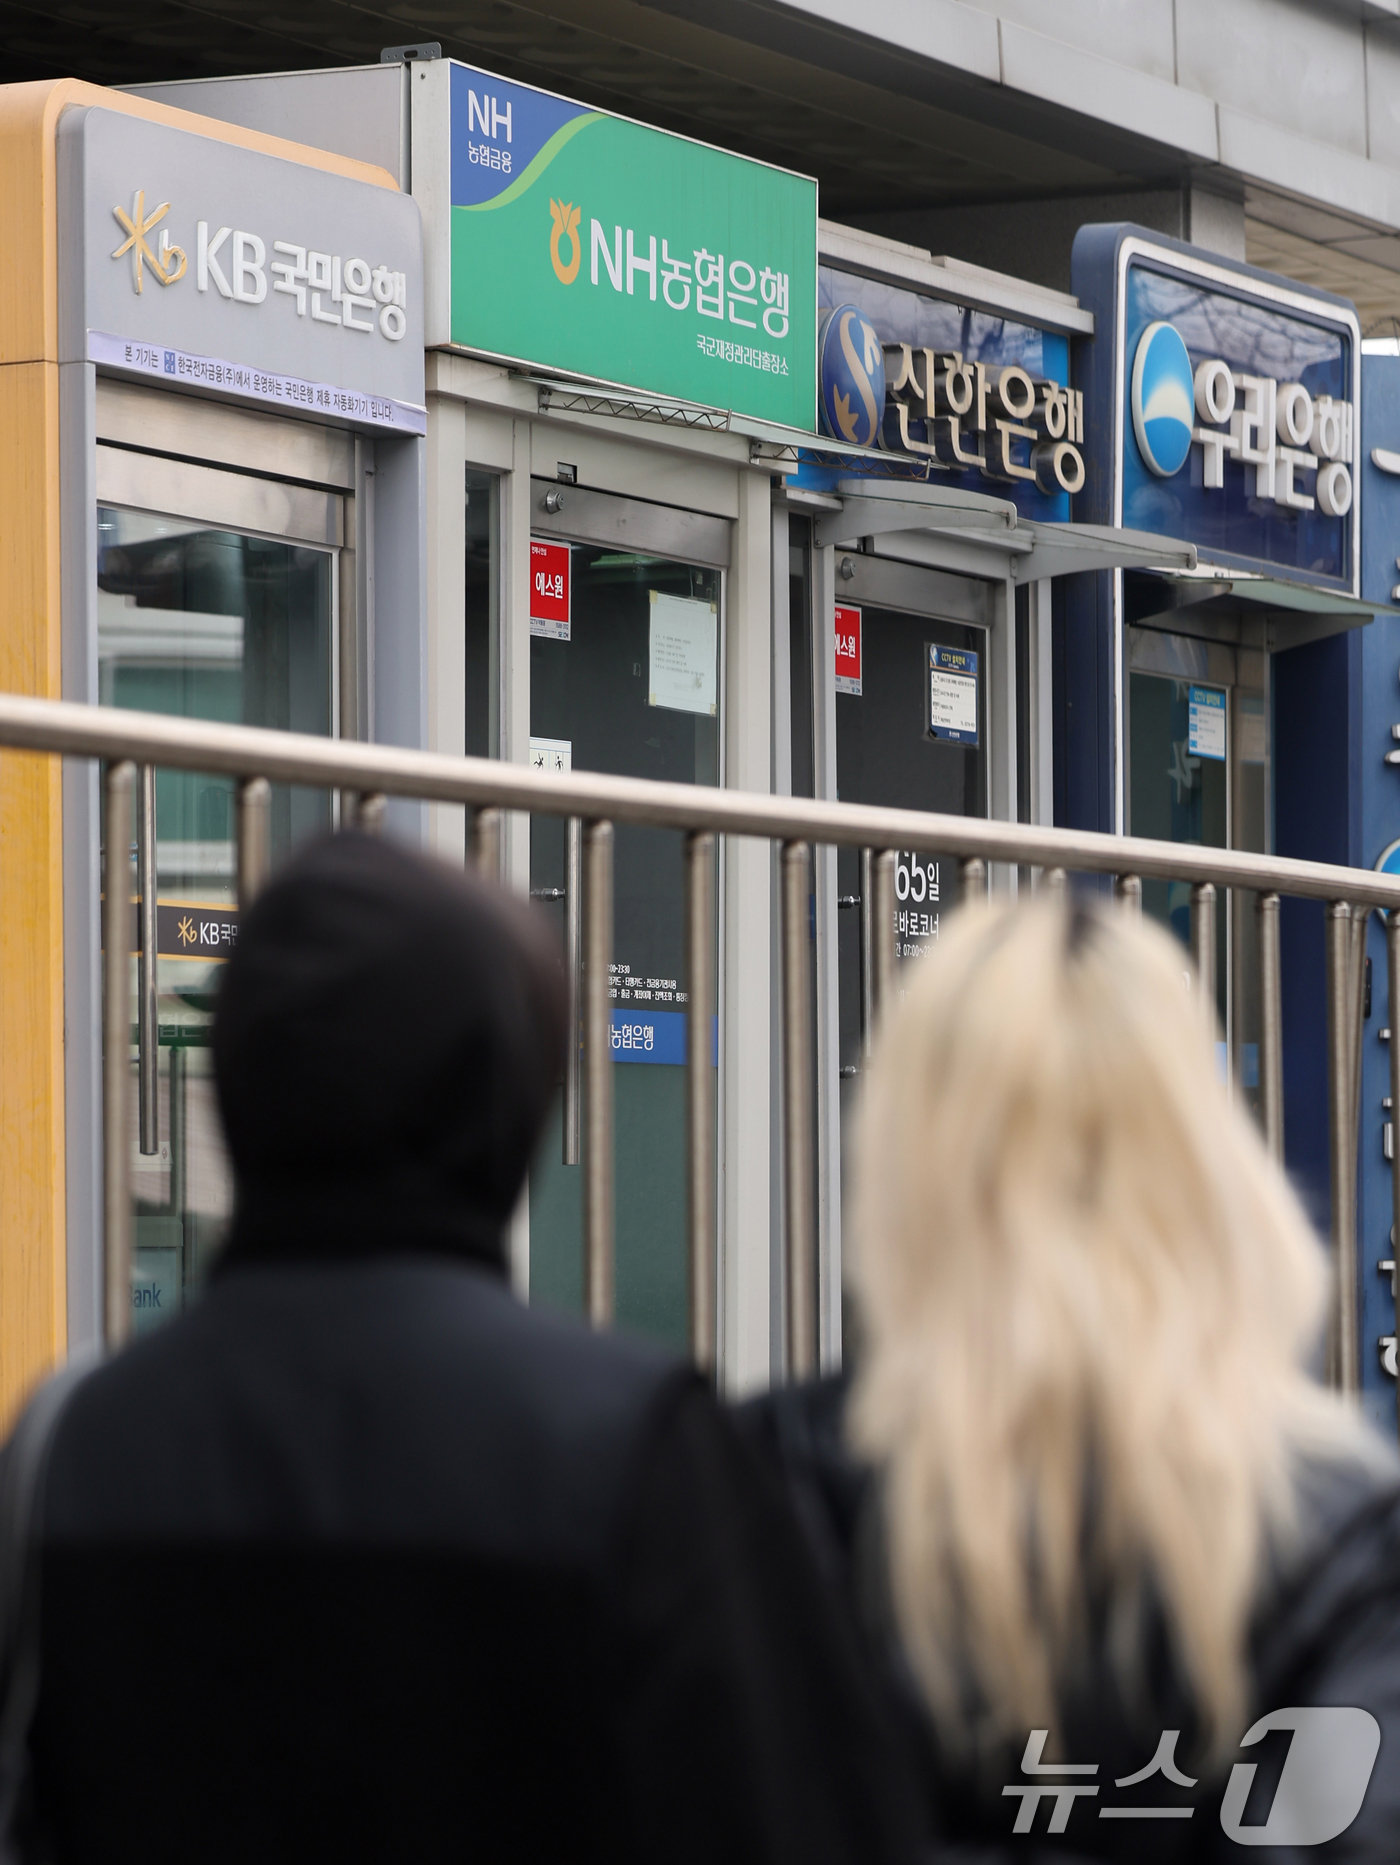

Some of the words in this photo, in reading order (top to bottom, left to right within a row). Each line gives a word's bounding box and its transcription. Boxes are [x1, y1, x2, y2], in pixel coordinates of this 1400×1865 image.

[467, 89, 513, 144] NH
[467, 140, 513, 174] 농협금융
[196, 220, 407, 341] KB국민은행
[590, 217, 790, 338] NH농협은행
[124, 344, 133, 363] 본
[135, 347, 159, 369] 기기는
[177, 355, 251, 389] 한국전자금융(주)에서
[253, 373, 283, 397] 운영하는
[285, 381, 314, 404] 국민은행
[316, 389, 331, 407] 제휴
[333, 393, 369, 416] 자동화기기
[370, 401, 394, 422] 입니다.
[696, 333, 790, 376] 국군재정관리단출장소
[888, 342, 1086, 495] 신한은행
[1193, 359, 1353, 518] 우리은행
[535, 572, 564, 599] 에스원
[607, 1023, 654, 1051] 농협은행
